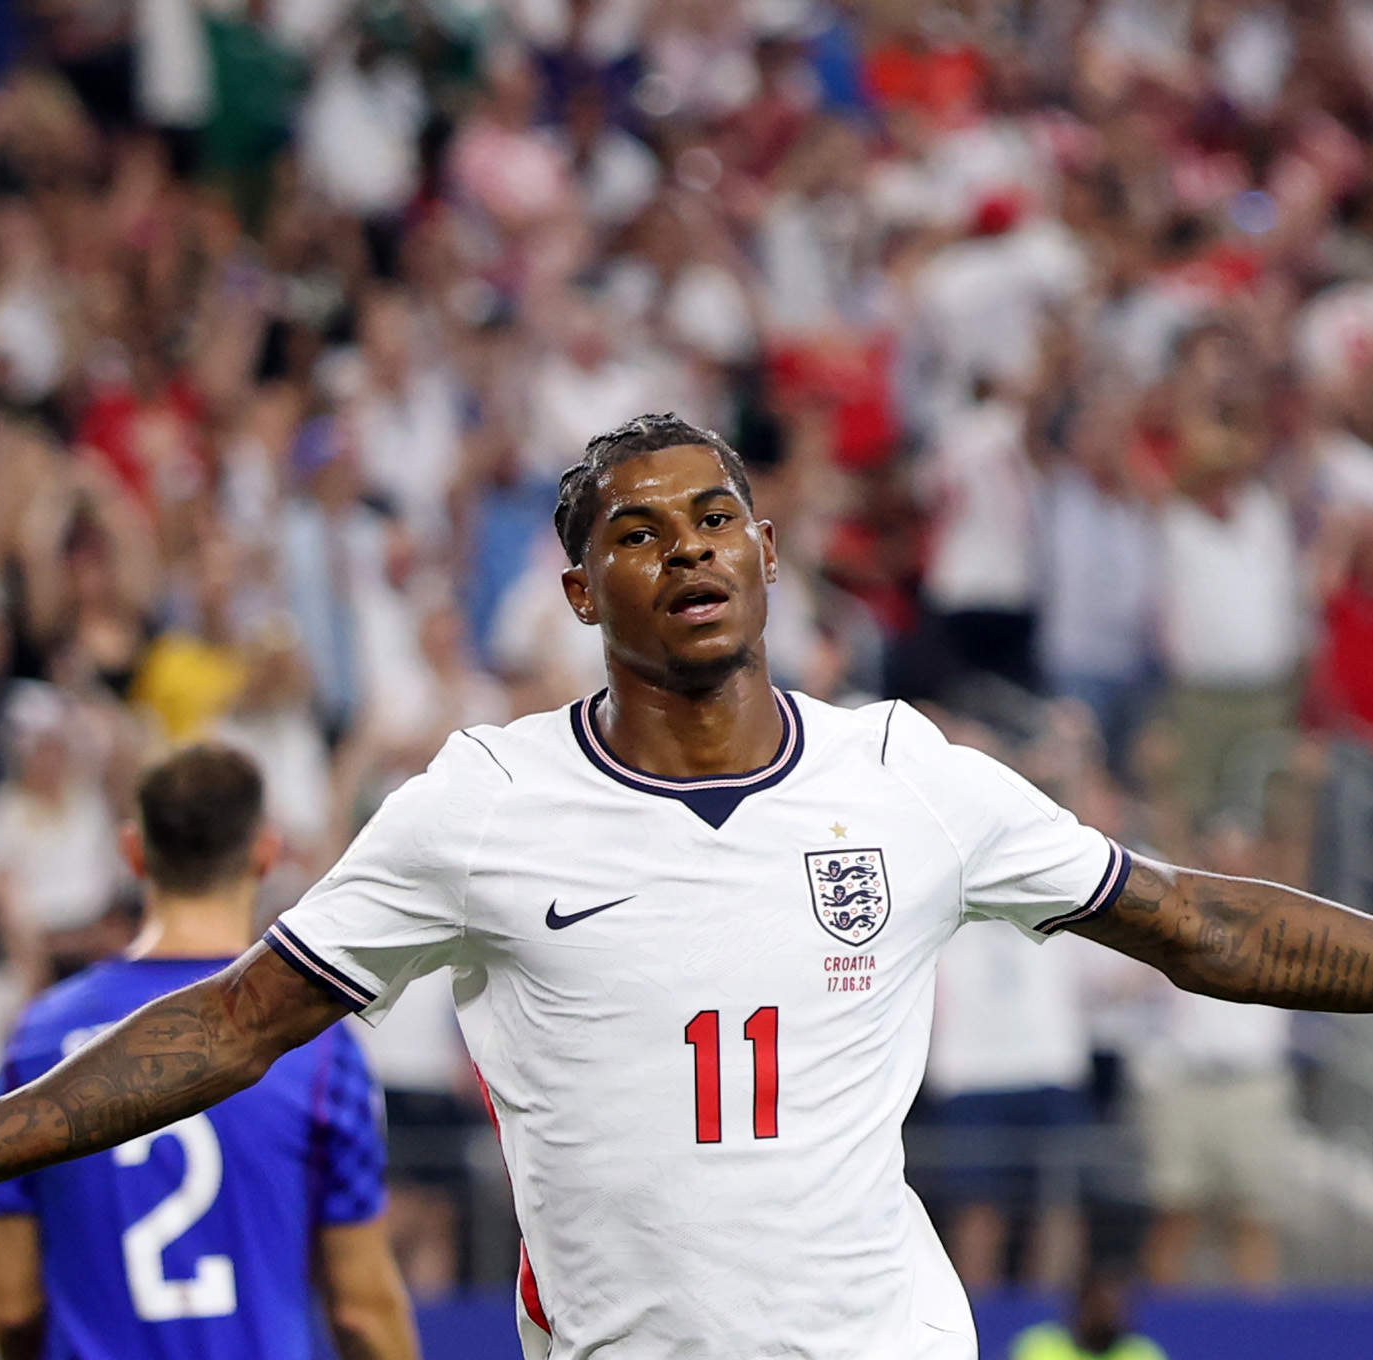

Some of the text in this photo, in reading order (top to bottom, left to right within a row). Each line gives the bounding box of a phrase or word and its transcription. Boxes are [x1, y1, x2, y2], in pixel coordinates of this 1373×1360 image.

[824, 955, 876, 971] CROATIA
[827, 976, 871, 992] 17.06.26
[685, 1006, 778, 1144] 11
[112, 1112, 237, 1322] 2
